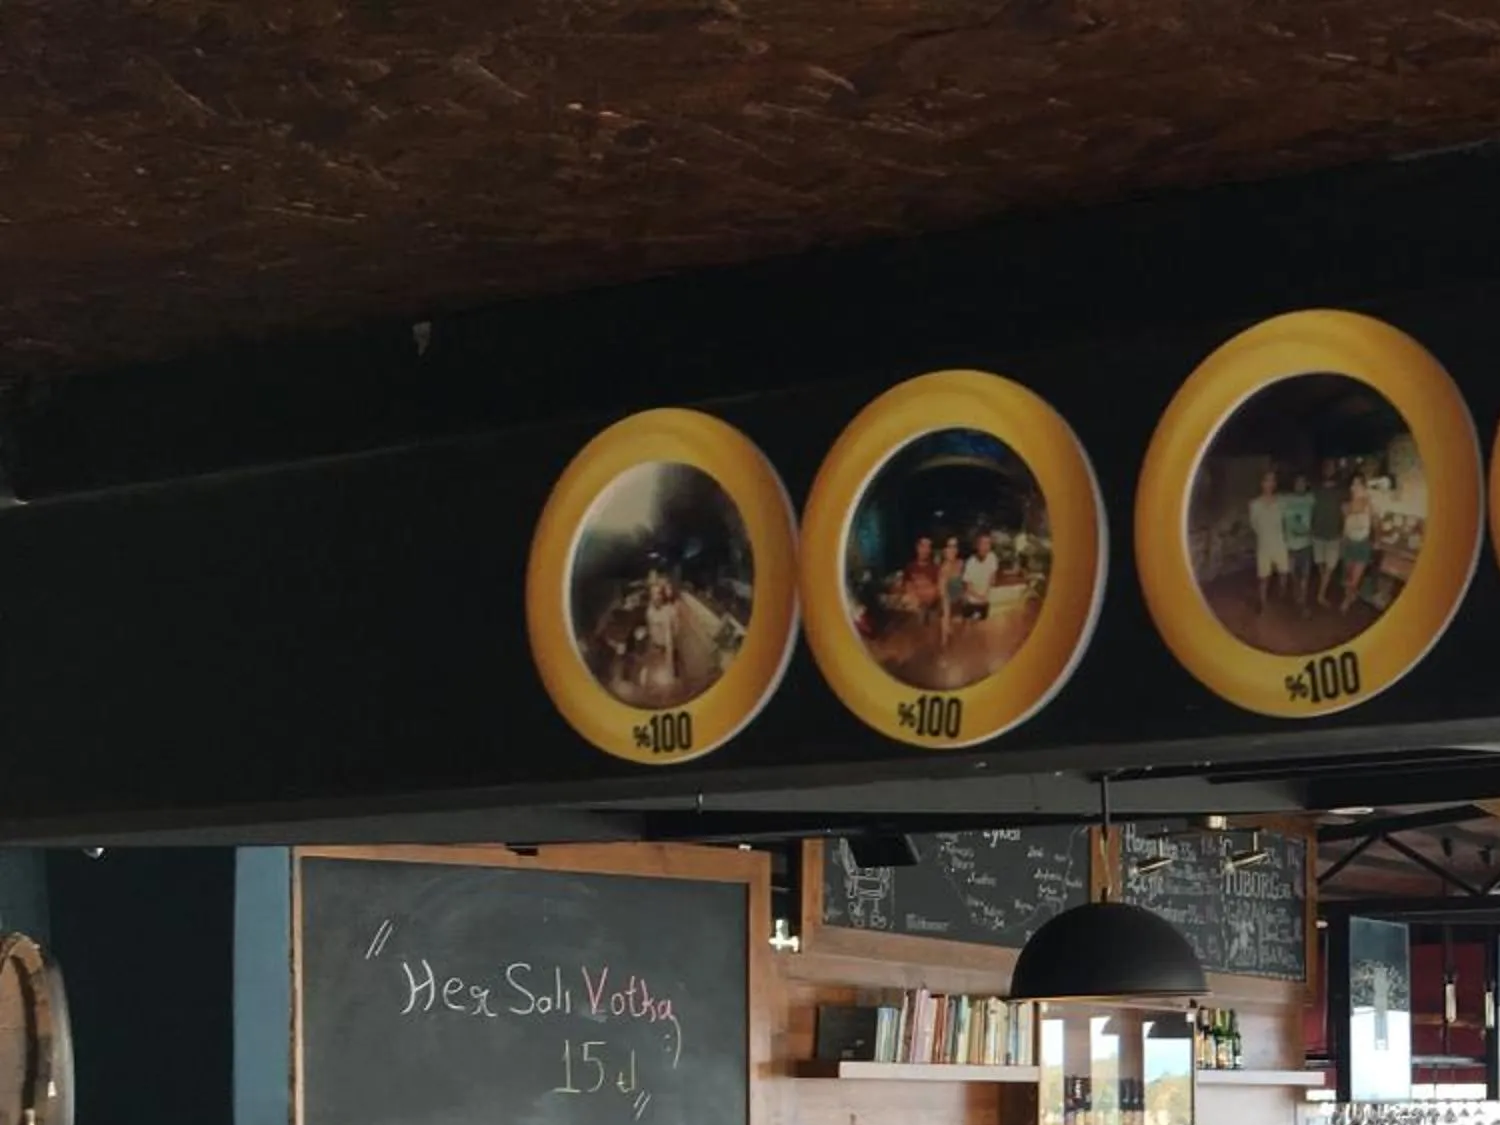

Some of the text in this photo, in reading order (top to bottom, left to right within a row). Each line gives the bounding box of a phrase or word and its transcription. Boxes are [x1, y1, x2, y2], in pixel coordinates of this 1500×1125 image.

[1284, 651, 1360, 704] %100
[633, 711, 693, 754] %100
[897, 695, 961, 738] %100
[553, 1039, 606, 1093] 15
